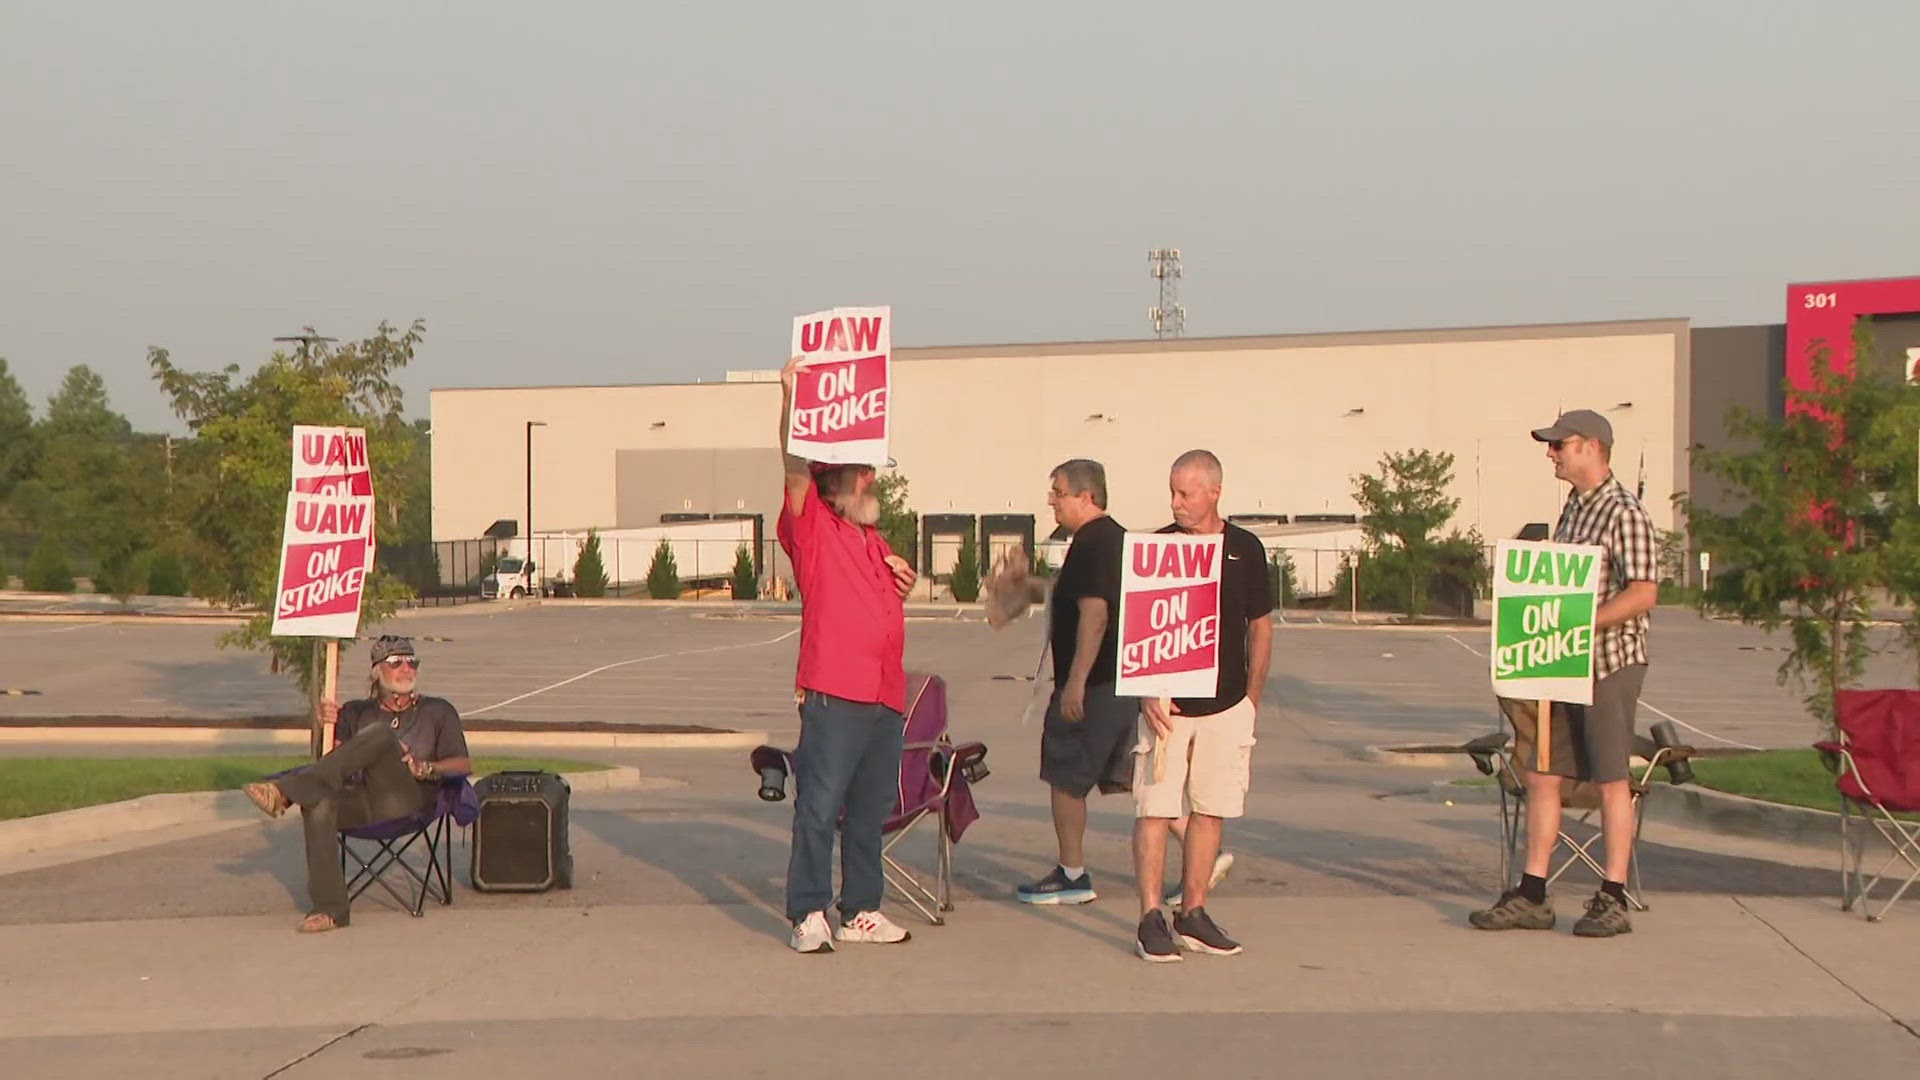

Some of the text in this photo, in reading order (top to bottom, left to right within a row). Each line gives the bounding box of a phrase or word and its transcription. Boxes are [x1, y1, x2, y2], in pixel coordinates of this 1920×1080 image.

[1804, 293, 1837, 308] 301
[801, 317, 882, 353] UAW
[818, 363, 857, 402] ON
[793, 387, 887, 437] STRIKE
[302, 434, 365, 467] UAW
[295, 501, 366, 534] UAW
[307, 545, 341, 578] ON
[1133, 543, 1216, 578] UAW
[1505, 549, 1594, 587] UAW
[279, 567, 364, 617] STRIKE
[1150, 591, 1188, 630] ON
[1522, 598, 1561, 635] ON
[1122, 615, 1217, 674] STRIKE
[1496, 625, 1591, 676] STRIKE
